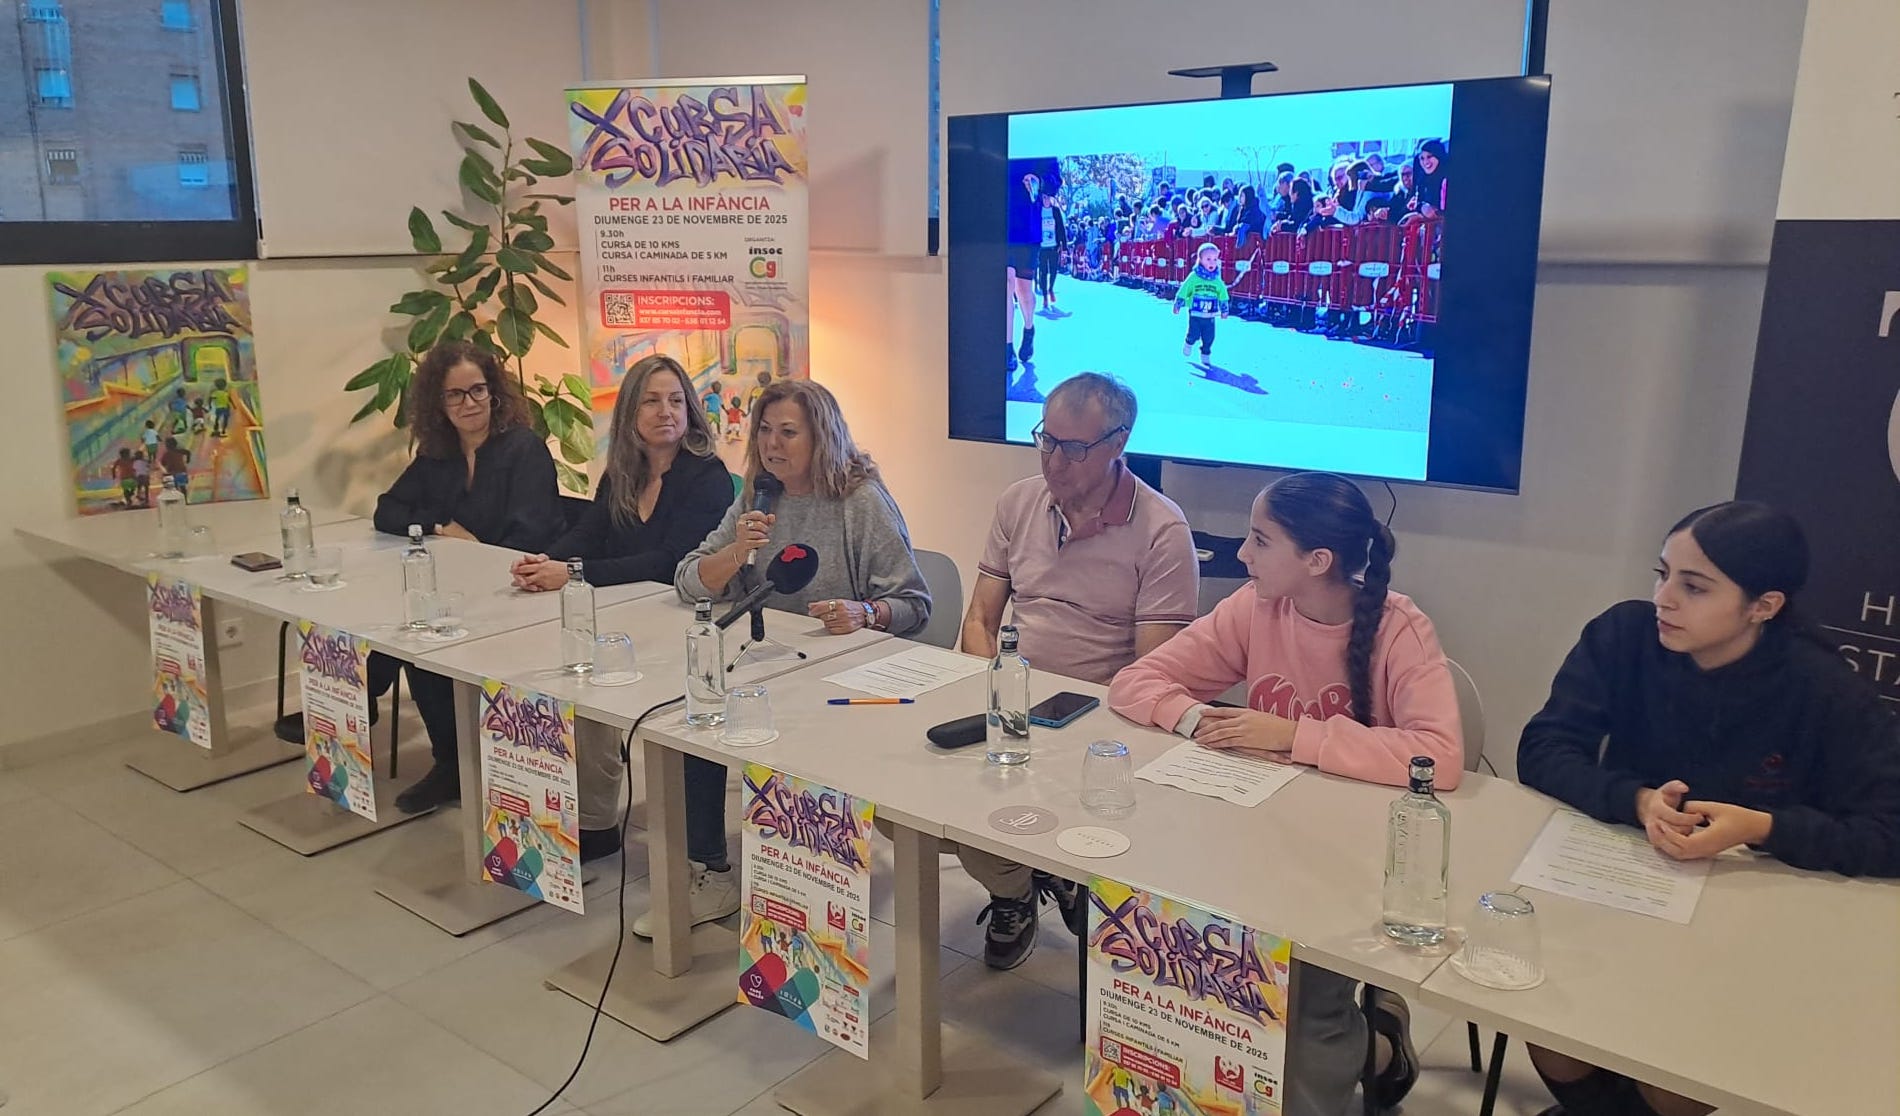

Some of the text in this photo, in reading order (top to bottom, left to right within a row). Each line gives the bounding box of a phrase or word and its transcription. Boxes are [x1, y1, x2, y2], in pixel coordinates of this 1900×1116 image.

[571, 85, 786, 170] X CURSA
[609, 193, 770, 211] PER A LA INFÀNCIA
[594, 215, 788, 224] DIUMENGE 23 DE NOVEMBRE DE 2025
[600, 230, 624, 238] 9.30h
[601, 241, 680, 249] CURSA DE 10 KMS
[749, 246, 783, 255] insoc
[602, 251, 635, 259] CURSA
[640, 251, 688, 259] CAMINADA
[691, 252, 704, 260] DE
[706, 252, 712, 260] 5
[714, 252, 728, 260] KM
[602, 265, 615, 273] 11h
[749, 256, 776, 278] Cg
[603, 274, 638, 282] CURSES
[640, 274, 685, 282] INFANTILS
[692, 275, 734, 283] FAMILIAR
[637, 295, 715, 306] INSCRIPCIONS:
[515, 753, 525, 764] LA
[761, 844, 851, 888] PER A LA INFÀNCIA
[751, 853, 784, 870] DIUMENGE
[793, 868, 801, 877] DE
[802, 872, 835, 892] NOVEMBRE
[836, 886, 845, 896] DE
[1089, 891, 1271, 985] X CURSA
[1113, 978, 1252, 1043] PER A LA INFÀNCIA
[1100, 988, 1268, 1061] DIUMENGE 23 DE NOVEMBRE DE 2025
